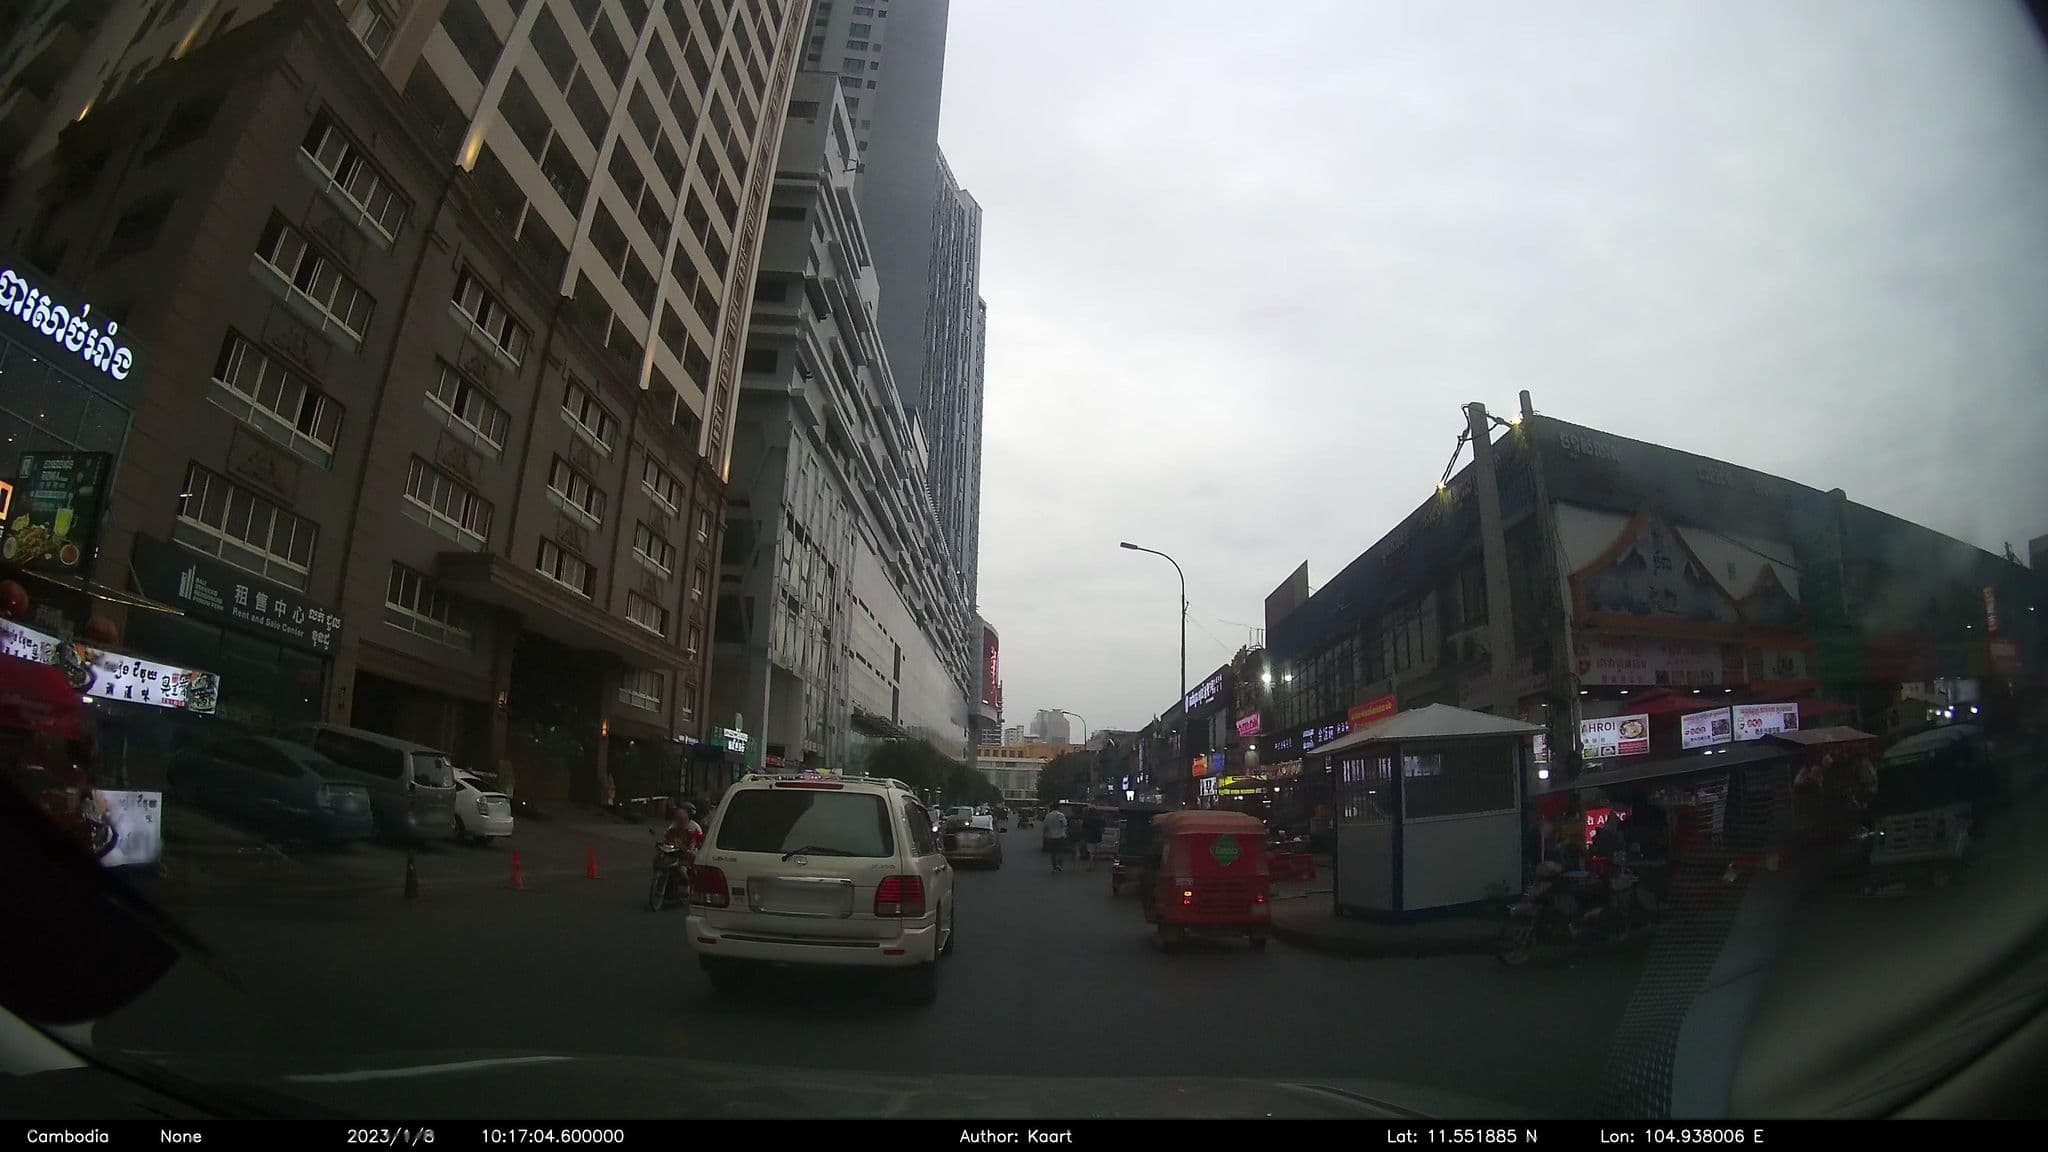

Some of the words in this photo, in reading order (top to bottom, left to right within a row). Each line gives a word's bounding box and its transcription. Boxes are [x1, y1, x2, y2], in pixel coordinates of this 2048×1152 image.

[232, 606, 250, 620] Rent
[251, 614, 265, 625] and
[265, 618, 281, 630] Sale
[282, 623, 304, 637] Center
[234, 584, 305, 624] 租售中心
